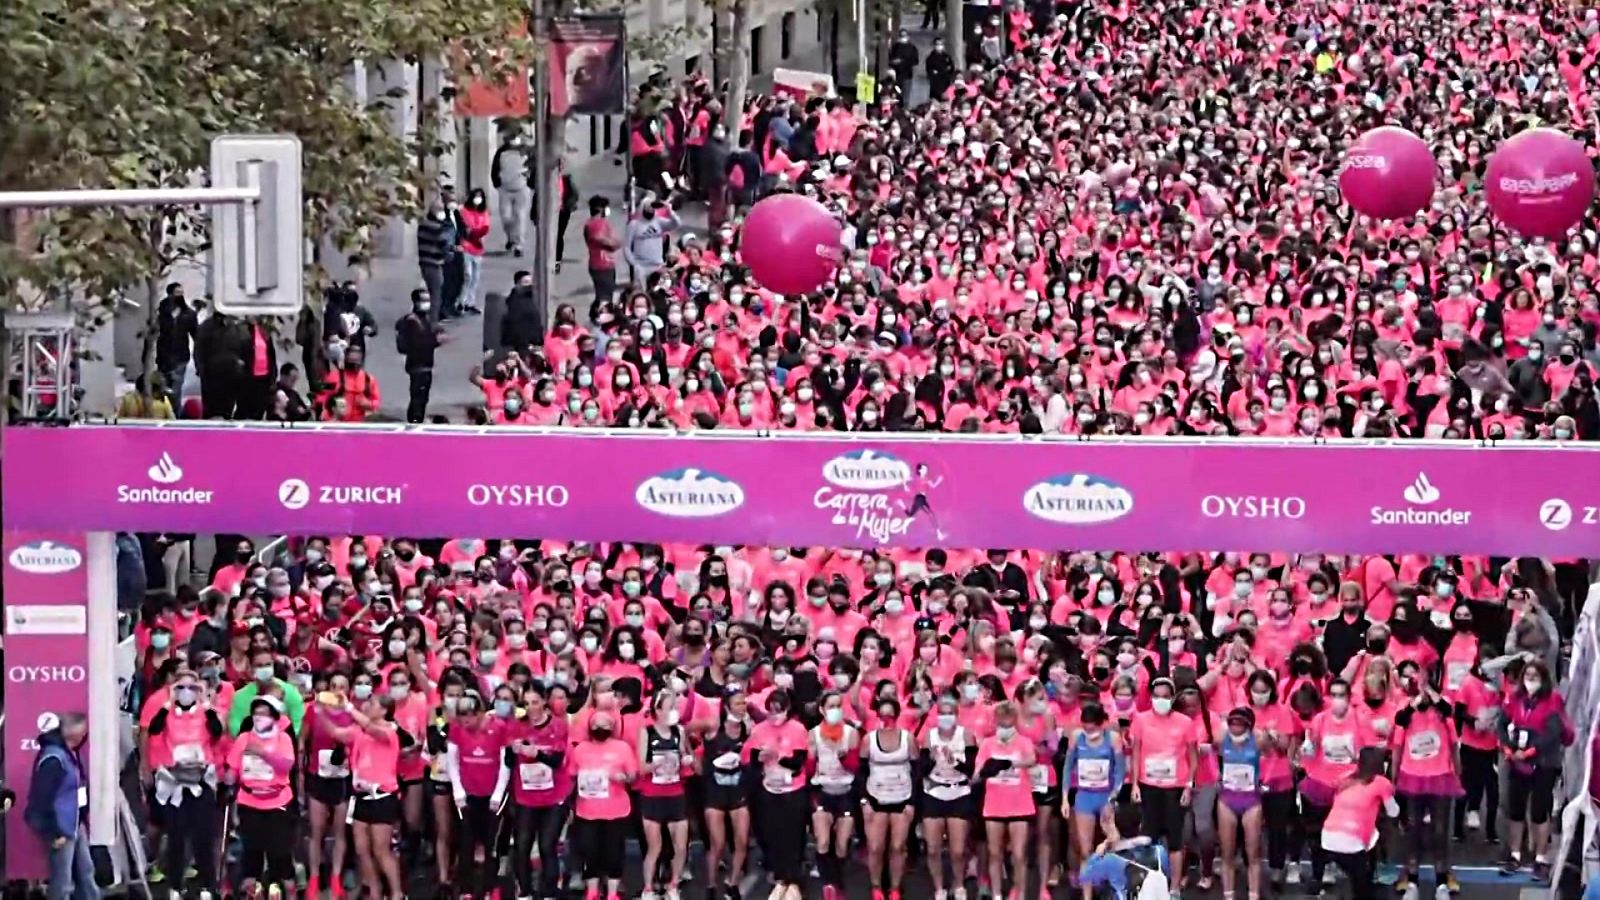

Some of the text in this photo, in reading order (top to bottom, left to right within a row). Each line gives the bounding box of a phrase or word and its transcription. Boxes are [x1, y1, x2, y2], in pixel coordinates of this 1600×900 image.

[117, 485, 214, 504] Santander
[319, 486, 401, 504] ZURICH
[467, 484, 569, 507] OYSHO
[646, 485, 737, 506] ASTURIANA
[814, 486, 888, 509] Carrera
[1030, 491, 1126, 512] ASTURIANA
[1201, 495, 1306, 519] OYSHO
[1370, 505, 1471, 525] Santander
[1582, 506, 1600, 524] Z
[856, 507, 916, 544] Mujer
[8, 665, 86, 683] OYSHO
